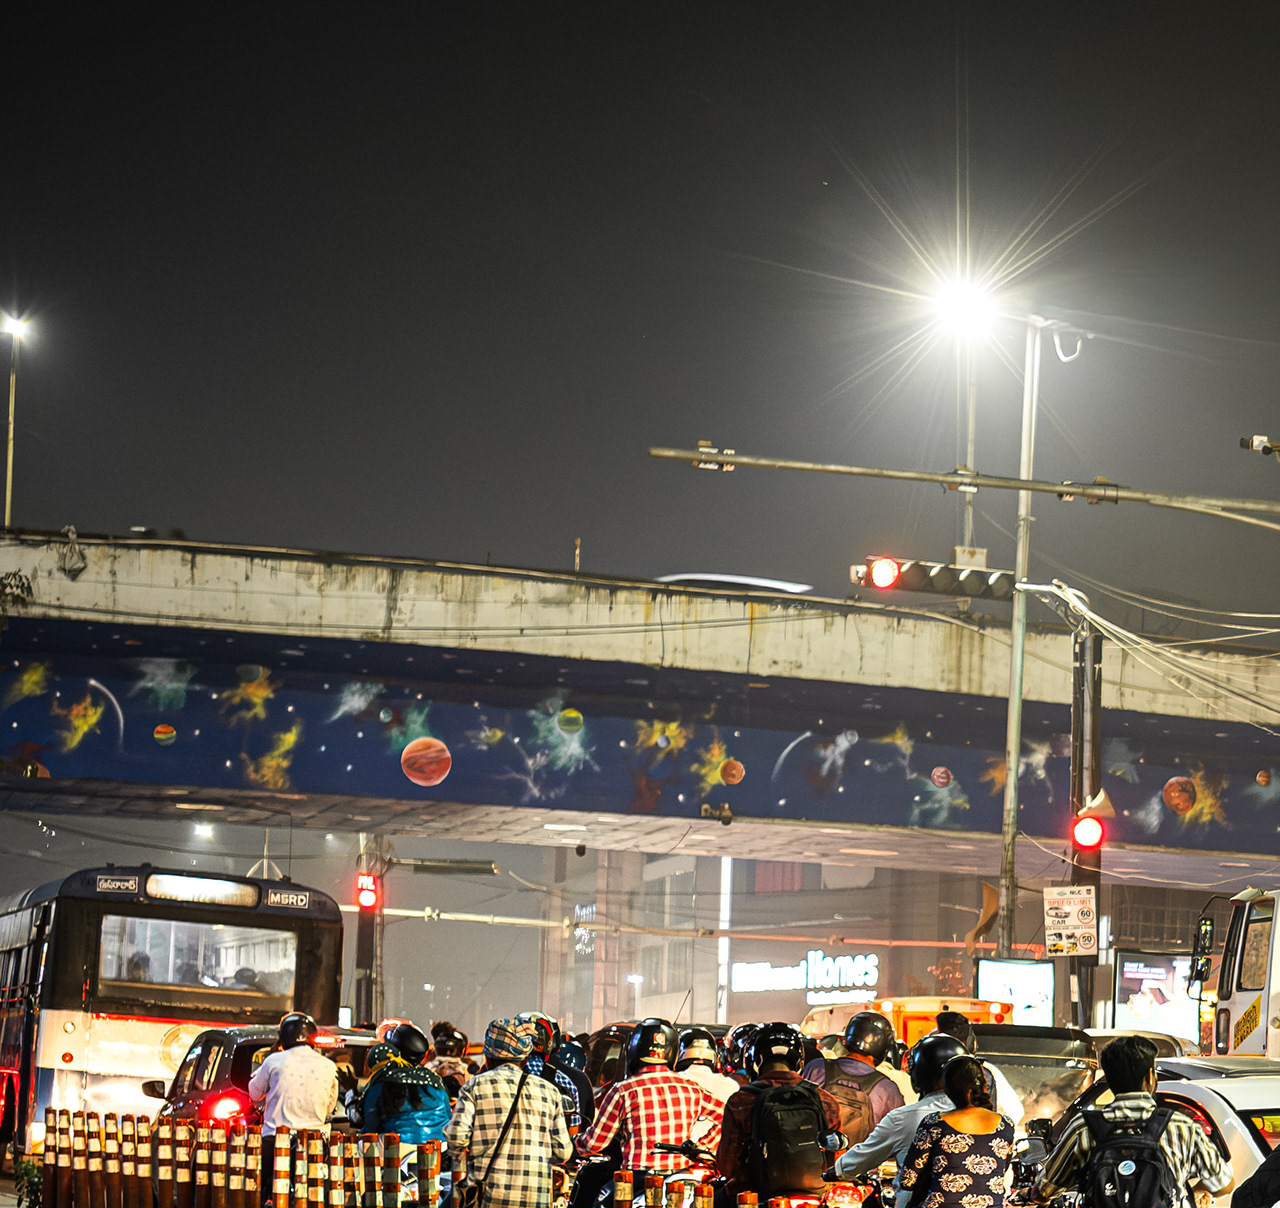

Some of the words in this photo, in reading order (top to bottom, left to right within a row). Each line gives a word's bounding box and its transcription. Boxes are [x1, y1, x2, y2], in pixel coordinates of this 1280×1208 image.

[1080, 910, 1091, 918] 60
[1082, 935, 1092, 943] 50
[807, 949, 879, 989] Homes
